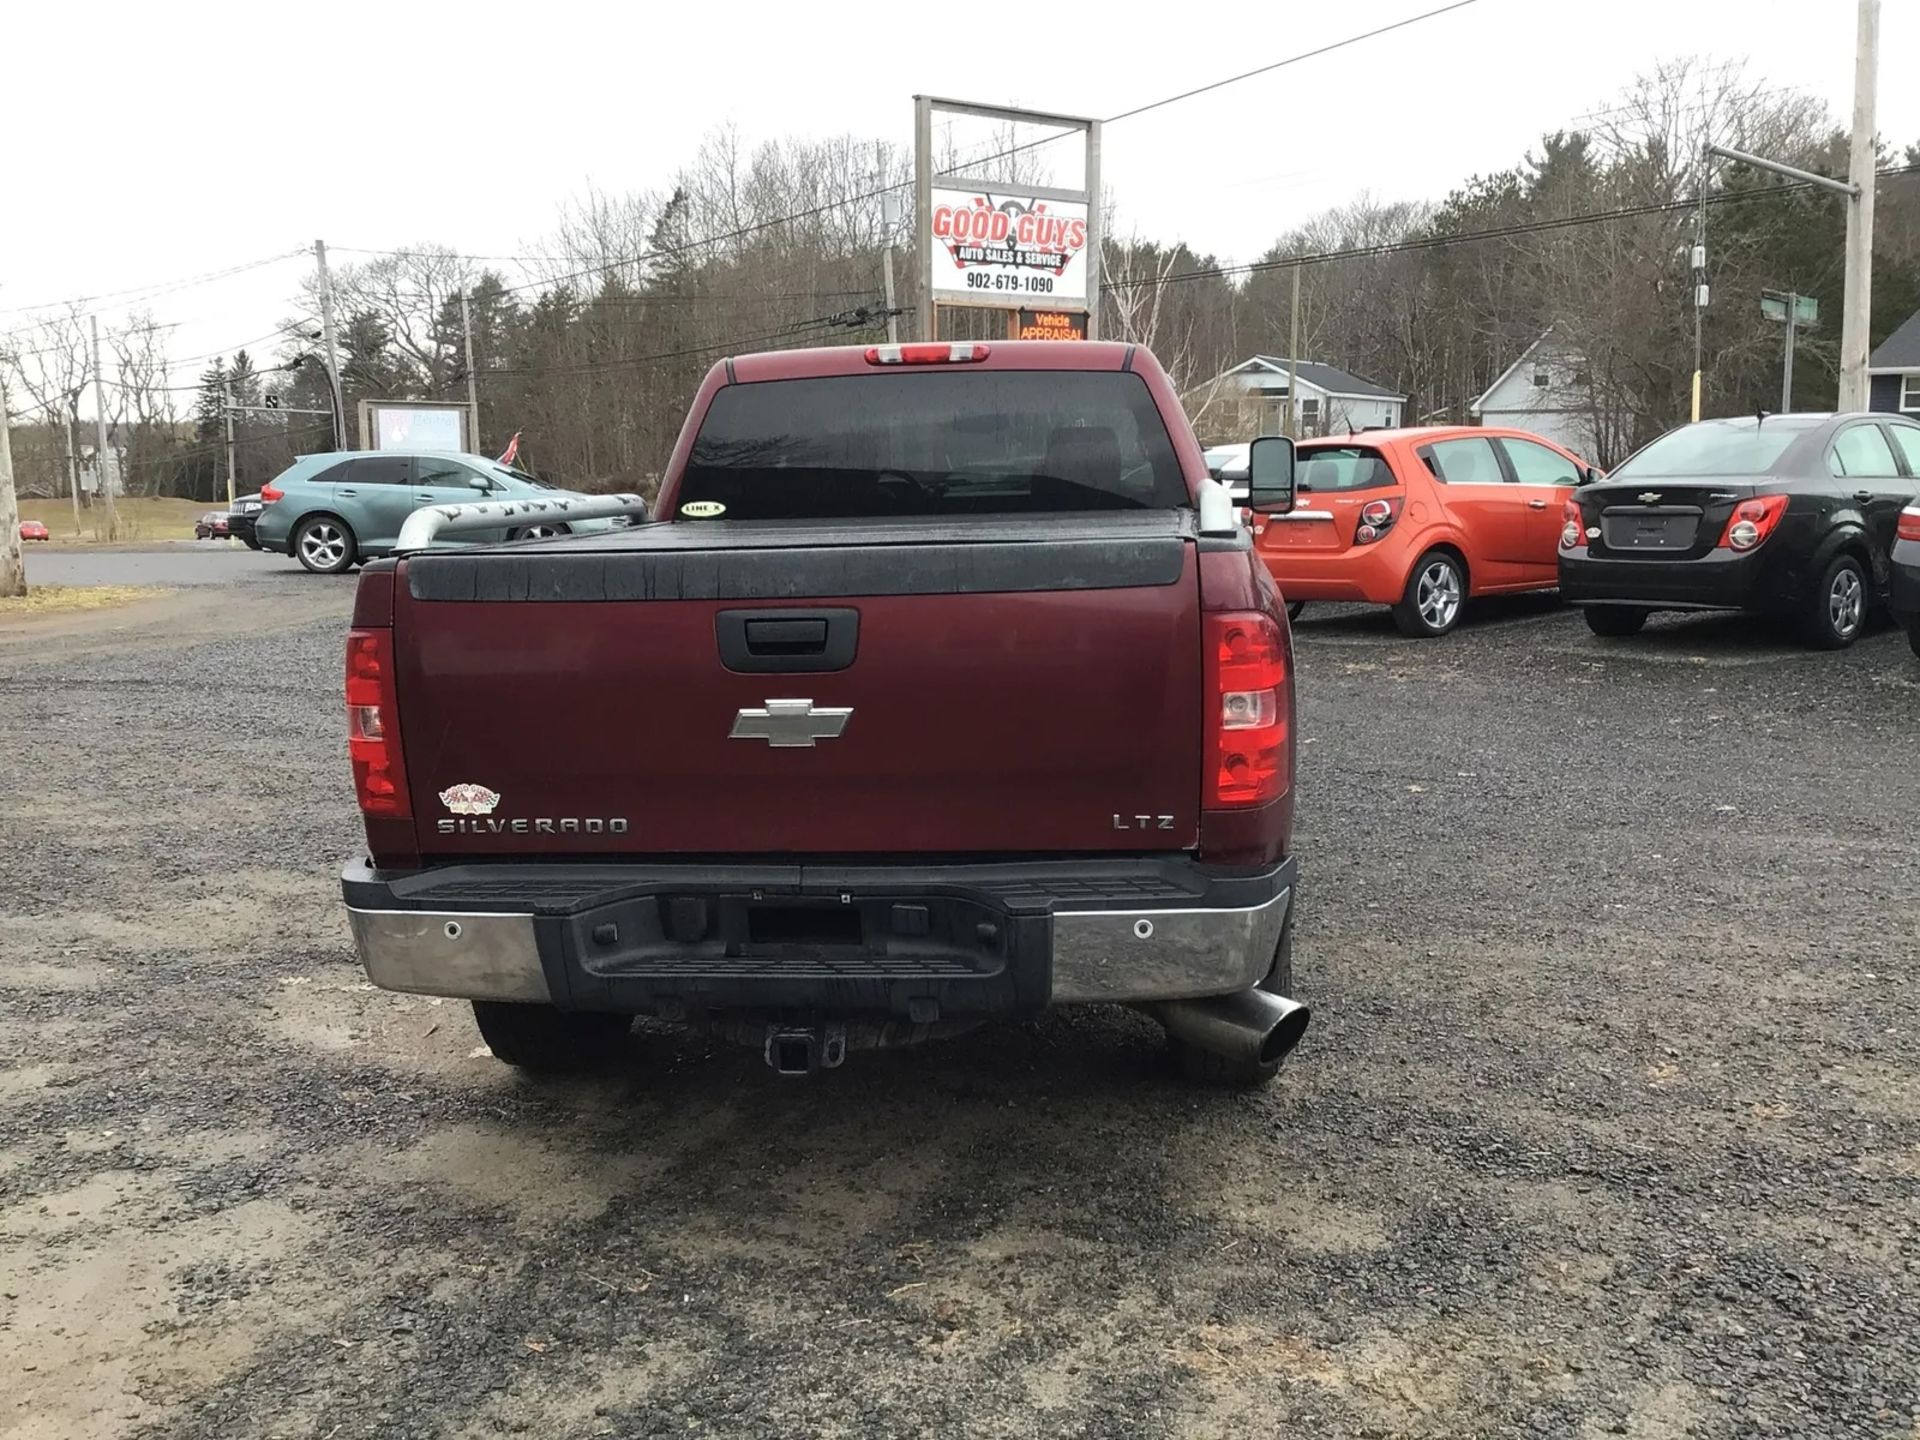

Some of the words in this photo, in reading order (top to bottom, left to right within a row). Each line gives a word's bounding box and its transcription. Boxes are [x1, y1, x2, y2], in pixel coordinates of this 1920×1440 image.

[932, 206, 1009, 242] GOOD
[1016, 213, 1087, 249] GUYS
[958, 247, 984, 261] AUTO
[985, 249, 1013, 263] SALES
[1016, 253, 1023, 263] &
[1024, 253, 1062, 267] SERVICE
[967, 272, 1054, 293] 902-679-1090
[1035, 313, 1070, 327] Vehicle
[437, 818, 628, 833] SILVERADO
[1113, 814, 1174, 829] LTZ
